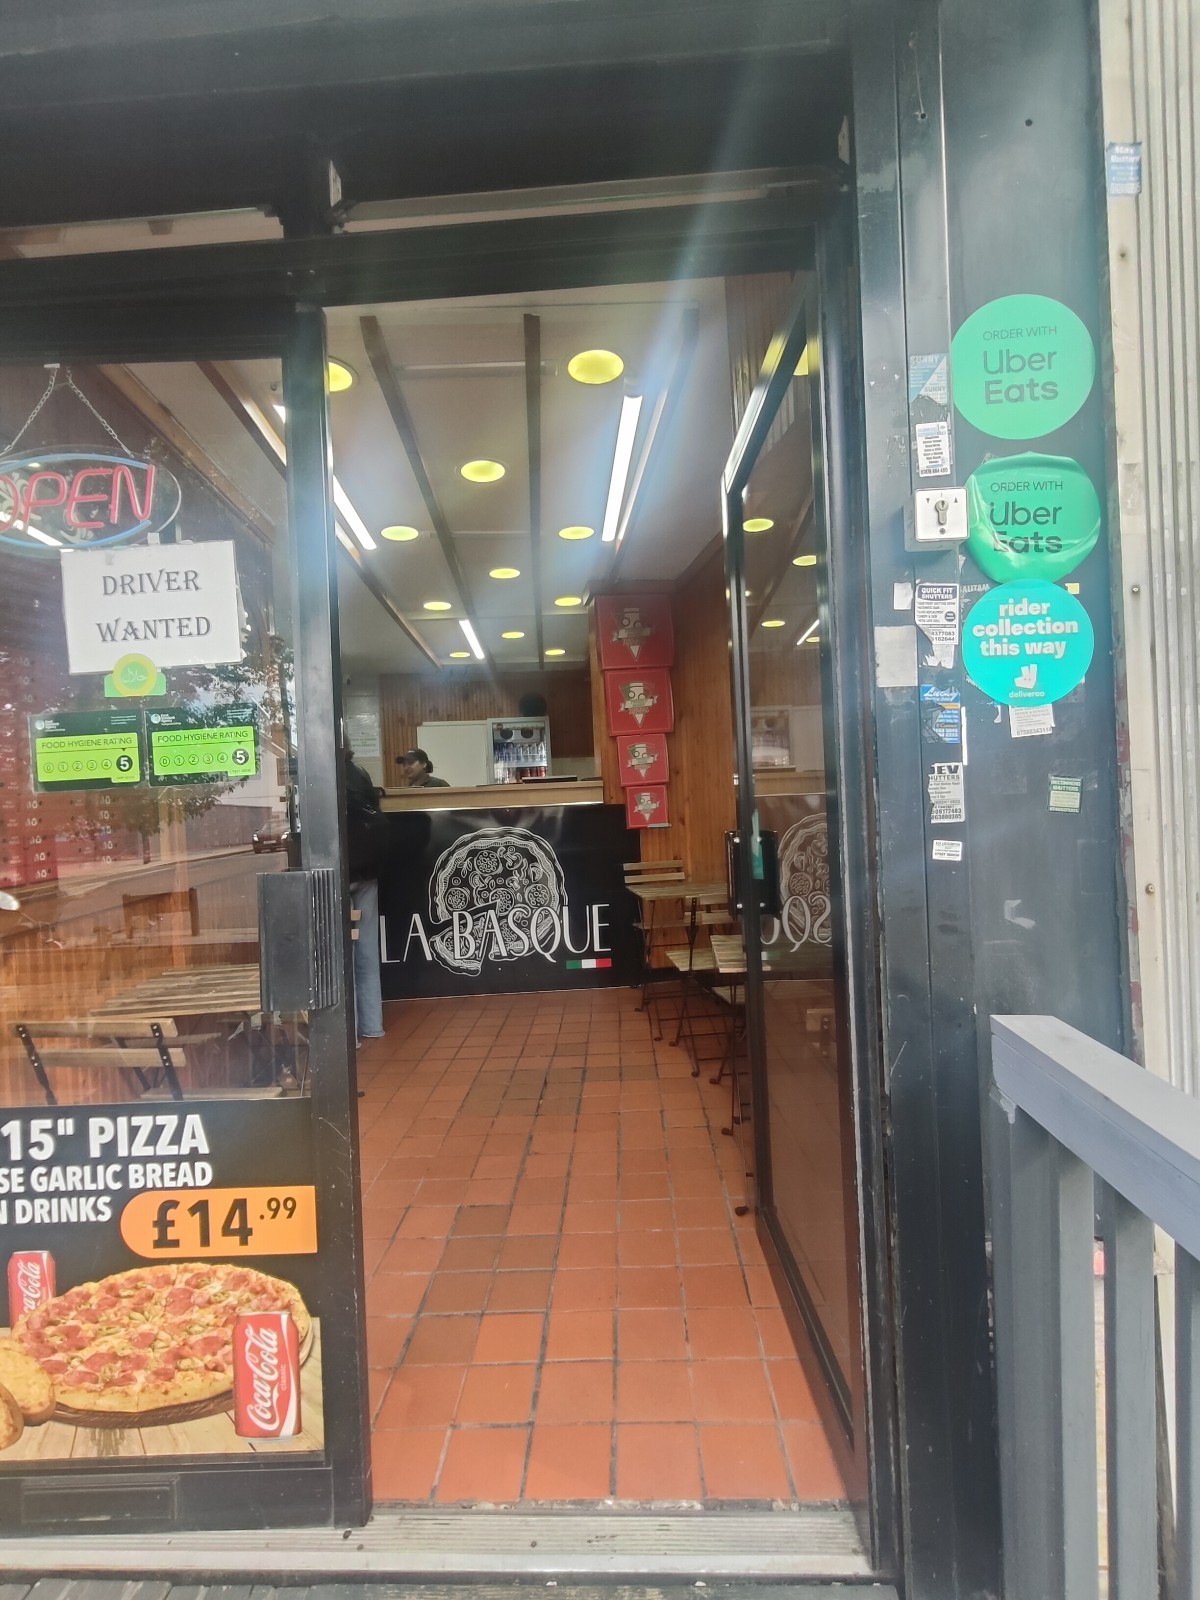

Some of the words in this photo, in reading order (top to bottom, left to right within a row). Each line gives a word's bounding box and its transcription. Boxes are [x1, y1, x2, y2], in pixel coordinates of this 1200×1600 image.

[982, 328, 1023, 340] ORDER
[1025, 325, 1057, 337] WITH
[983, 348, 1057, 375] Uber
[985, 378, 1058, 404] Eats
[990, 482, 1030, 493] ORDER
[1032, 481, 1063, 491] WITH
[989, 501, 1063, 526] Uber
[102, 568, 201, 595] DRIVER
[999, 597, 1051, 616] rider
[96, 617, 212, 642] WANTED
[972, 616, 1079, 637] collection
[980, 638, 1020, 656] this
[1024, 641, 1066, 659] way
[1008, 690, 1045, 698] deliveroo
[42, 741, 66, 749] FOOD
[68, 738, 102, 748] HYGIENE
[103, 736, 132, 745] RATING
[157, 735, 182, 743] FOOD
[183, 732, 218, 742] HYGIENE
[219, 730, 249, 739] RATING
[120, 757, 129, 770] 5
[236, 750, 245, 763] 5
[379, 913, 433, 963] LA
[453, 903, 612, 963] BASQUE
[1, 1118, 74, 1160] 15"
[89, 1114, 210, 1158] PIZZA
[30, 1164, 123, 1193] GARLIC
[128, 1161, 213, 1189] BREAD
[15, 1196, 112, 1224] DRINKS
